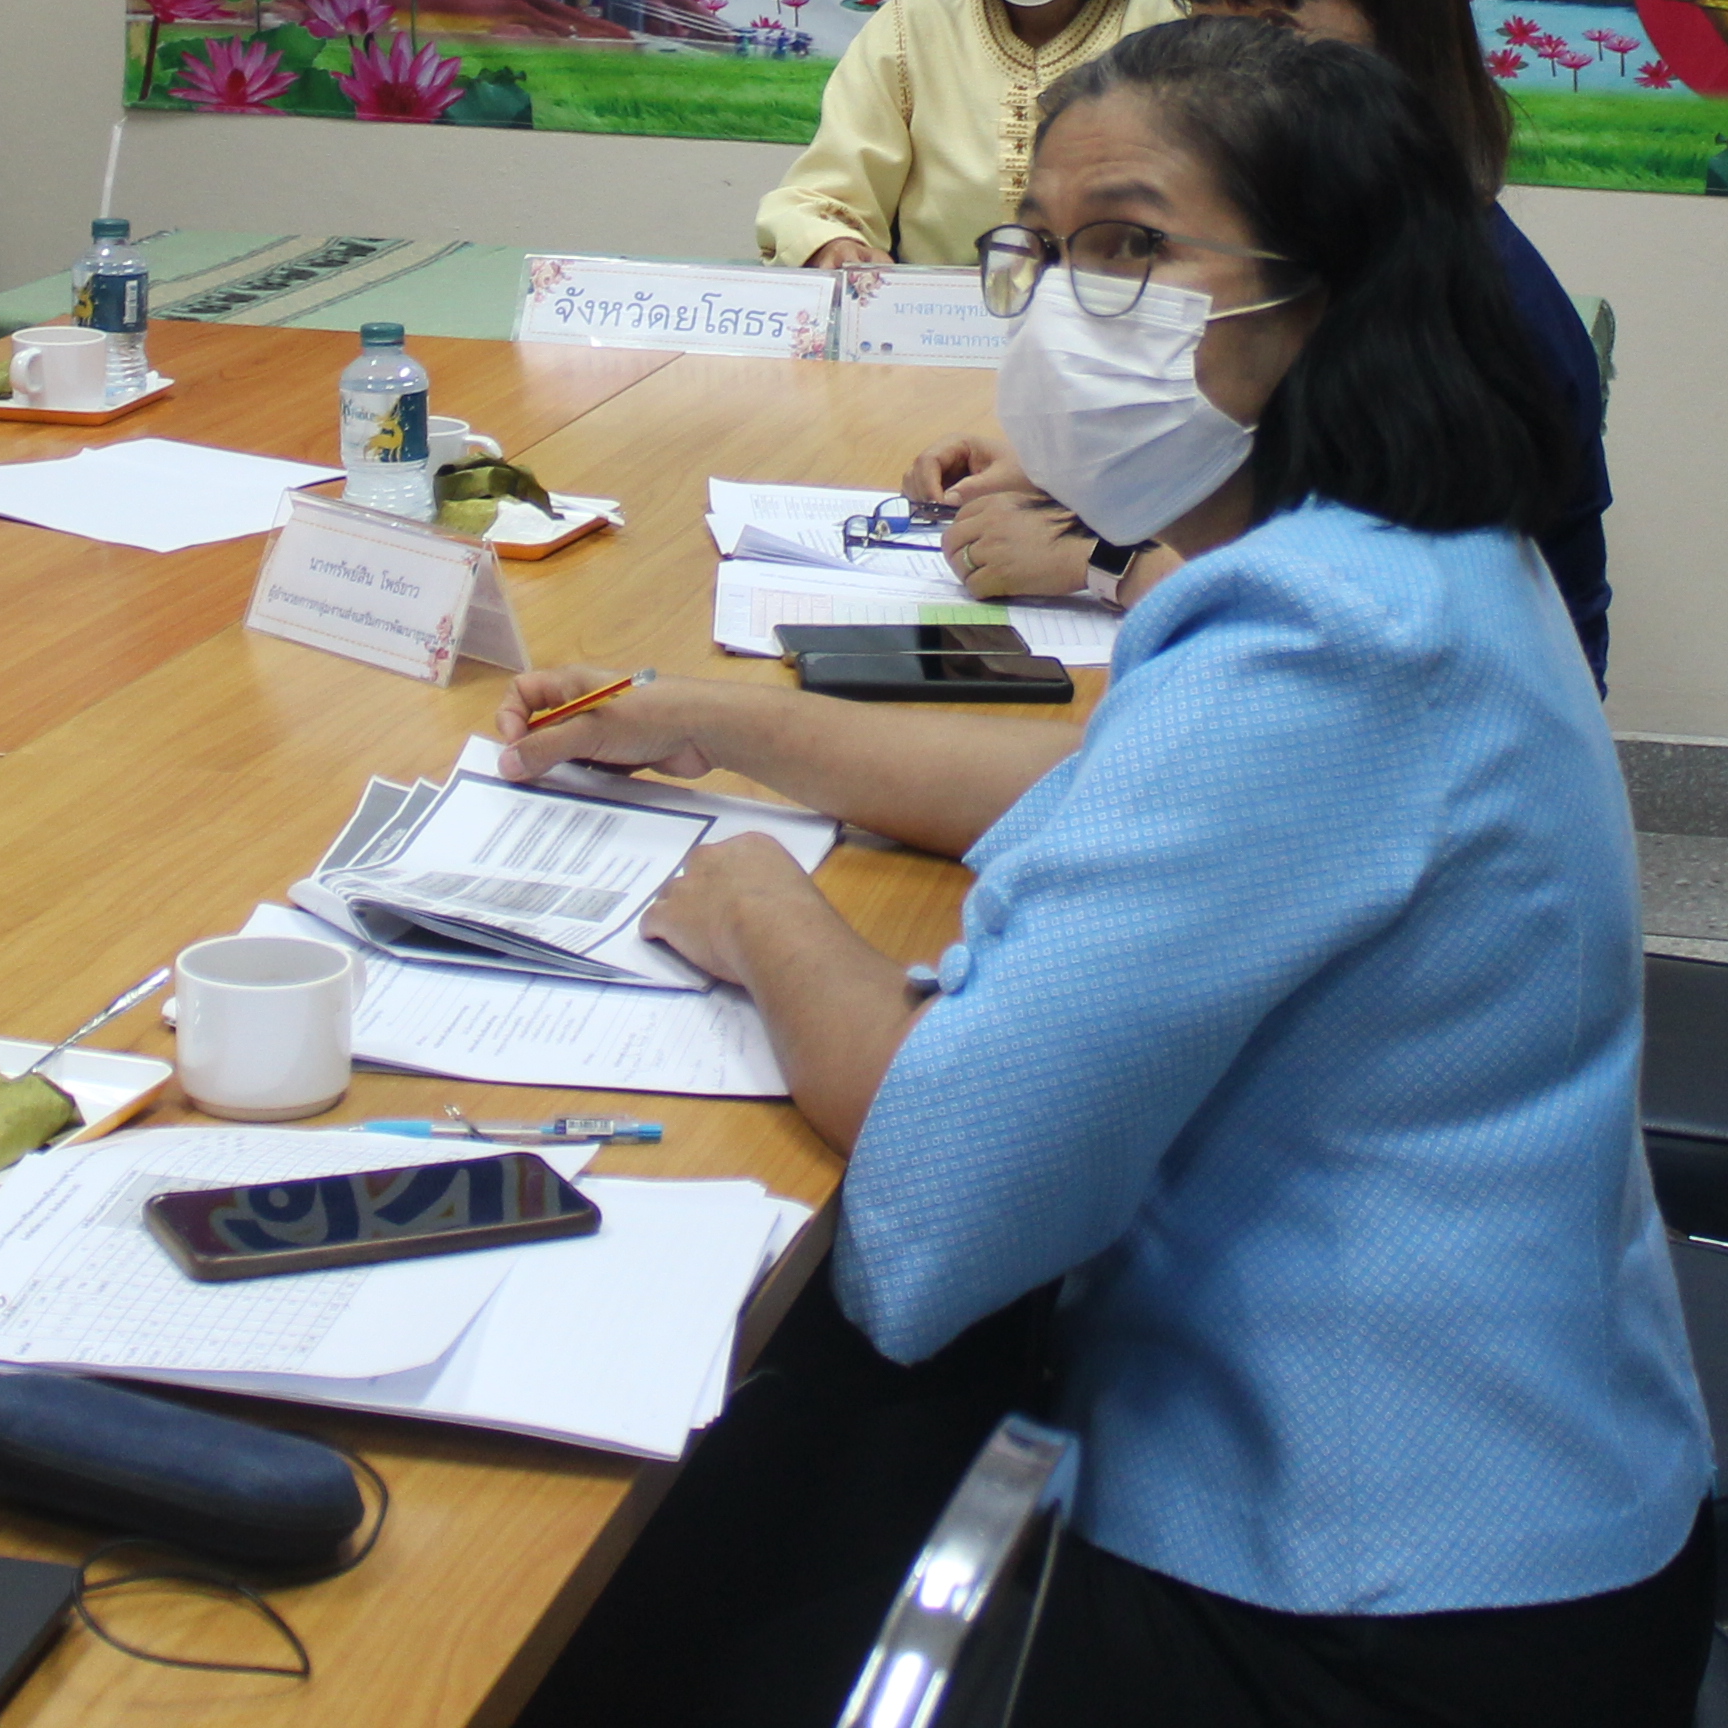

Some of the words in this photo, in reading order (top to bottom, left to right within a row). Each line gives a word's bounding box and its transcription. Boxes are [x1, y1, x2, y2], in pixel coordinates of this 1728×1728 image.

[553, 284, 791, 339] จังหวัดยโสธร
